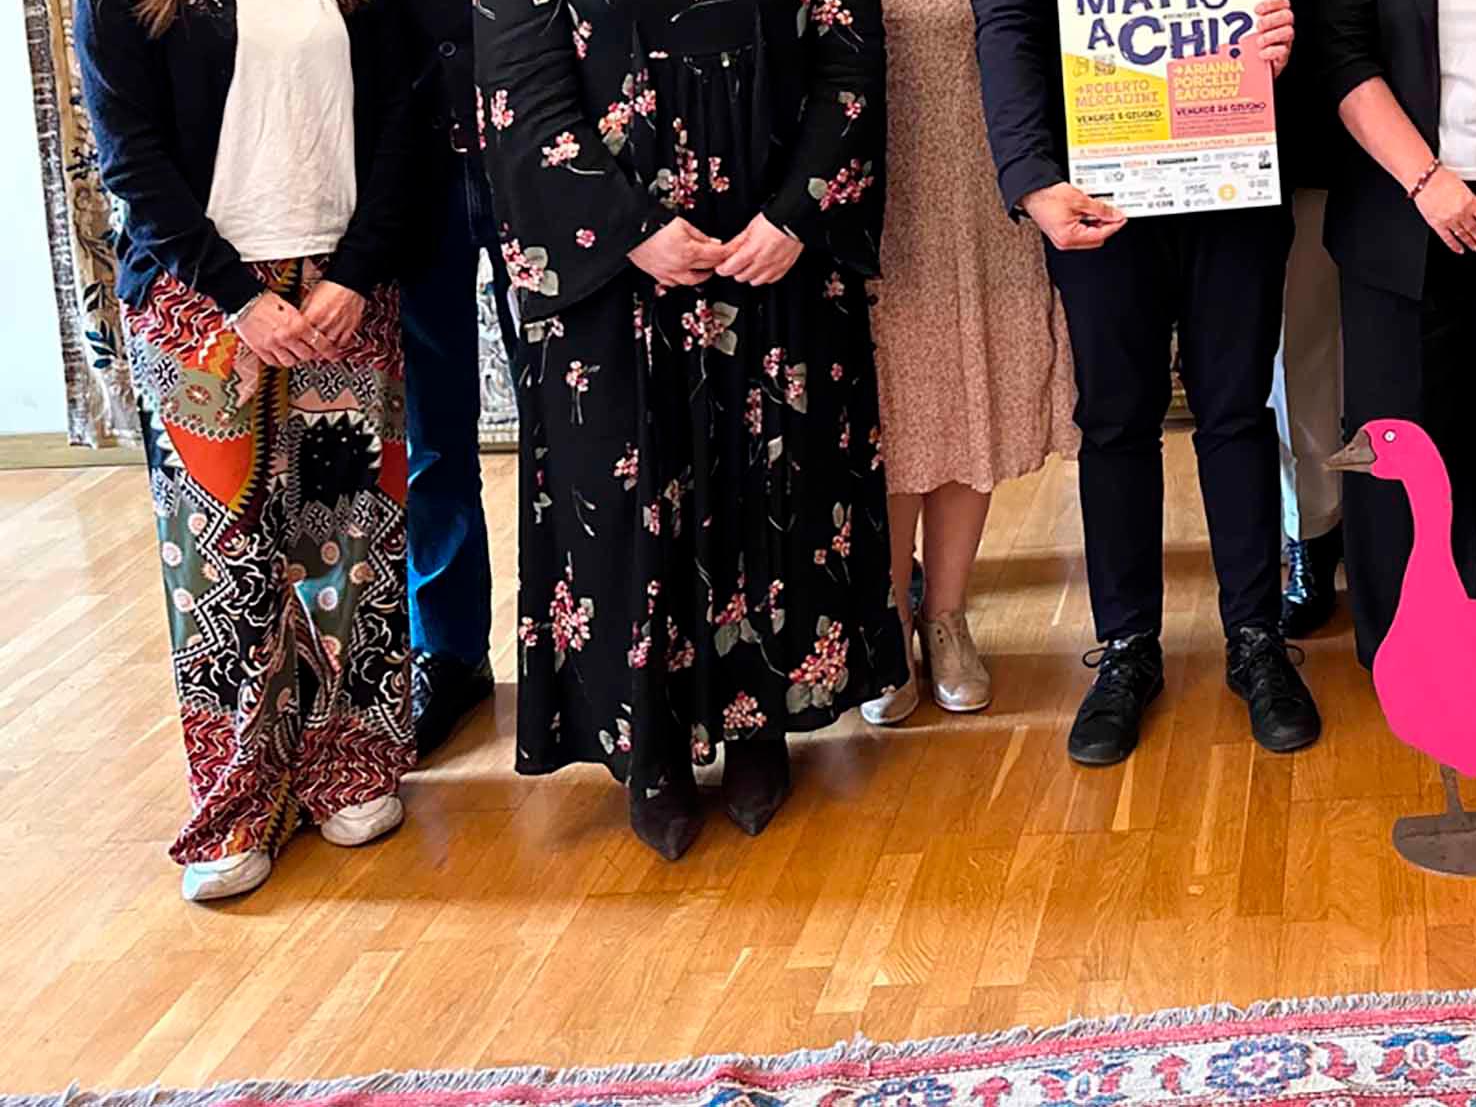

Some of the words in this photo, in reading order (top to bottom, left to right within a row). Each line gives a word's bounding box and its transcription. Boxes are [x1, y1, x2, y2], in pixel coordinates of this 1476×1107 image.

[1088, 18, 1115, 50] A
[1118, 11, 1254, 66] CHI?
[1184, 59, 1245, 75] ARIANNA
[1084, 78, 1150, 95] ROBERTO
[1174, 73, 1240, 89] PORCELLI
[1075, 90, 1160, 108] MERCADINI
